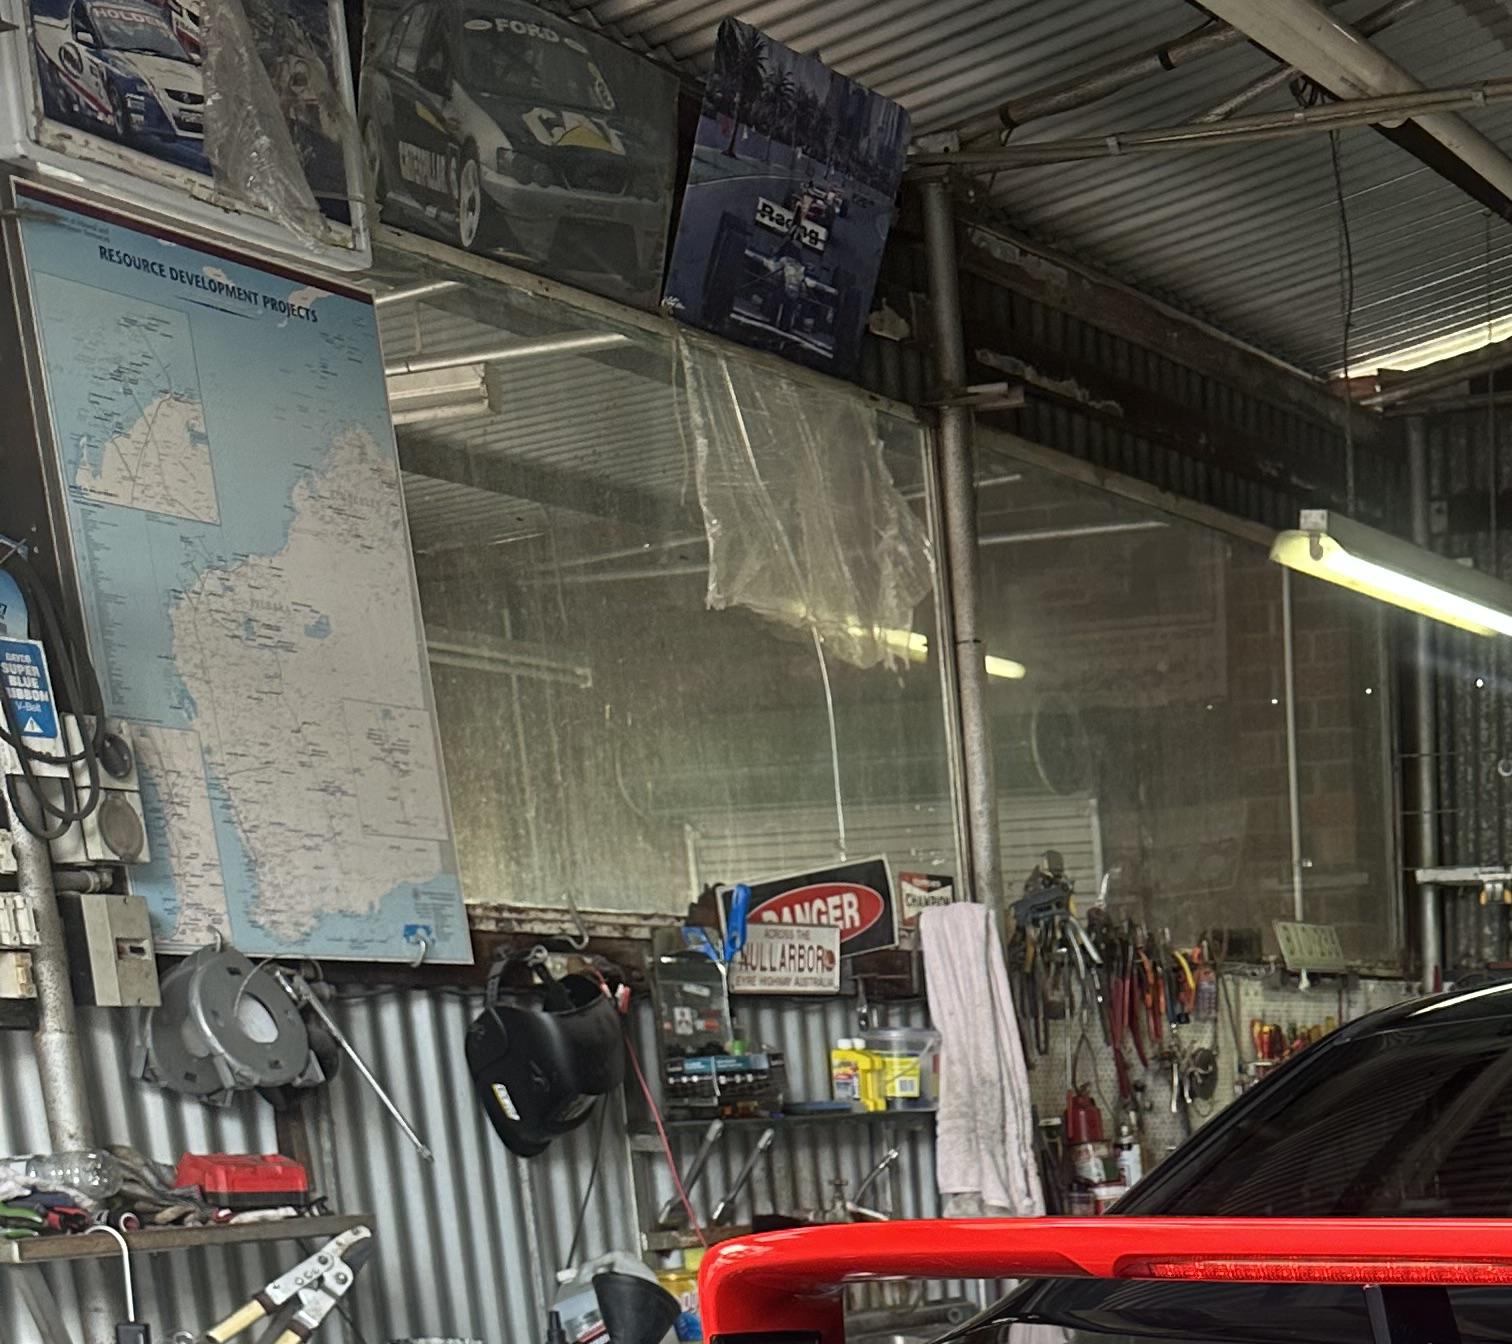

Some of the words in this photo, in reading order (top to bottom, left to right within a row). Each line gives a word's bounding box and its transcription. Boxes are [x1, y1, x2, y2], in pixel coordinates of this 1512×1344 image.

[495, 18, 559, 43] FORD
[759, 203, 820, 246] Racng
[98, 244, 167, 279] RESOURCE
[169, 267, 259, 305] DEVELOPMENT
[262, 295, 319, 323] PROJECTS
[1, 661, 41, 678] SUPER
[8, 674, 40, 689] BLUE
[15, 701, 42, 713] V-Belt
[764, 928, 794, 941] ACROSS
[799, 928, 811, 941] THE
[739, 943, 826, 973] NULLARBOR
[735, 975, 756, 987] EYRE
[794, 975, 834, 987] AUSTRALIA
